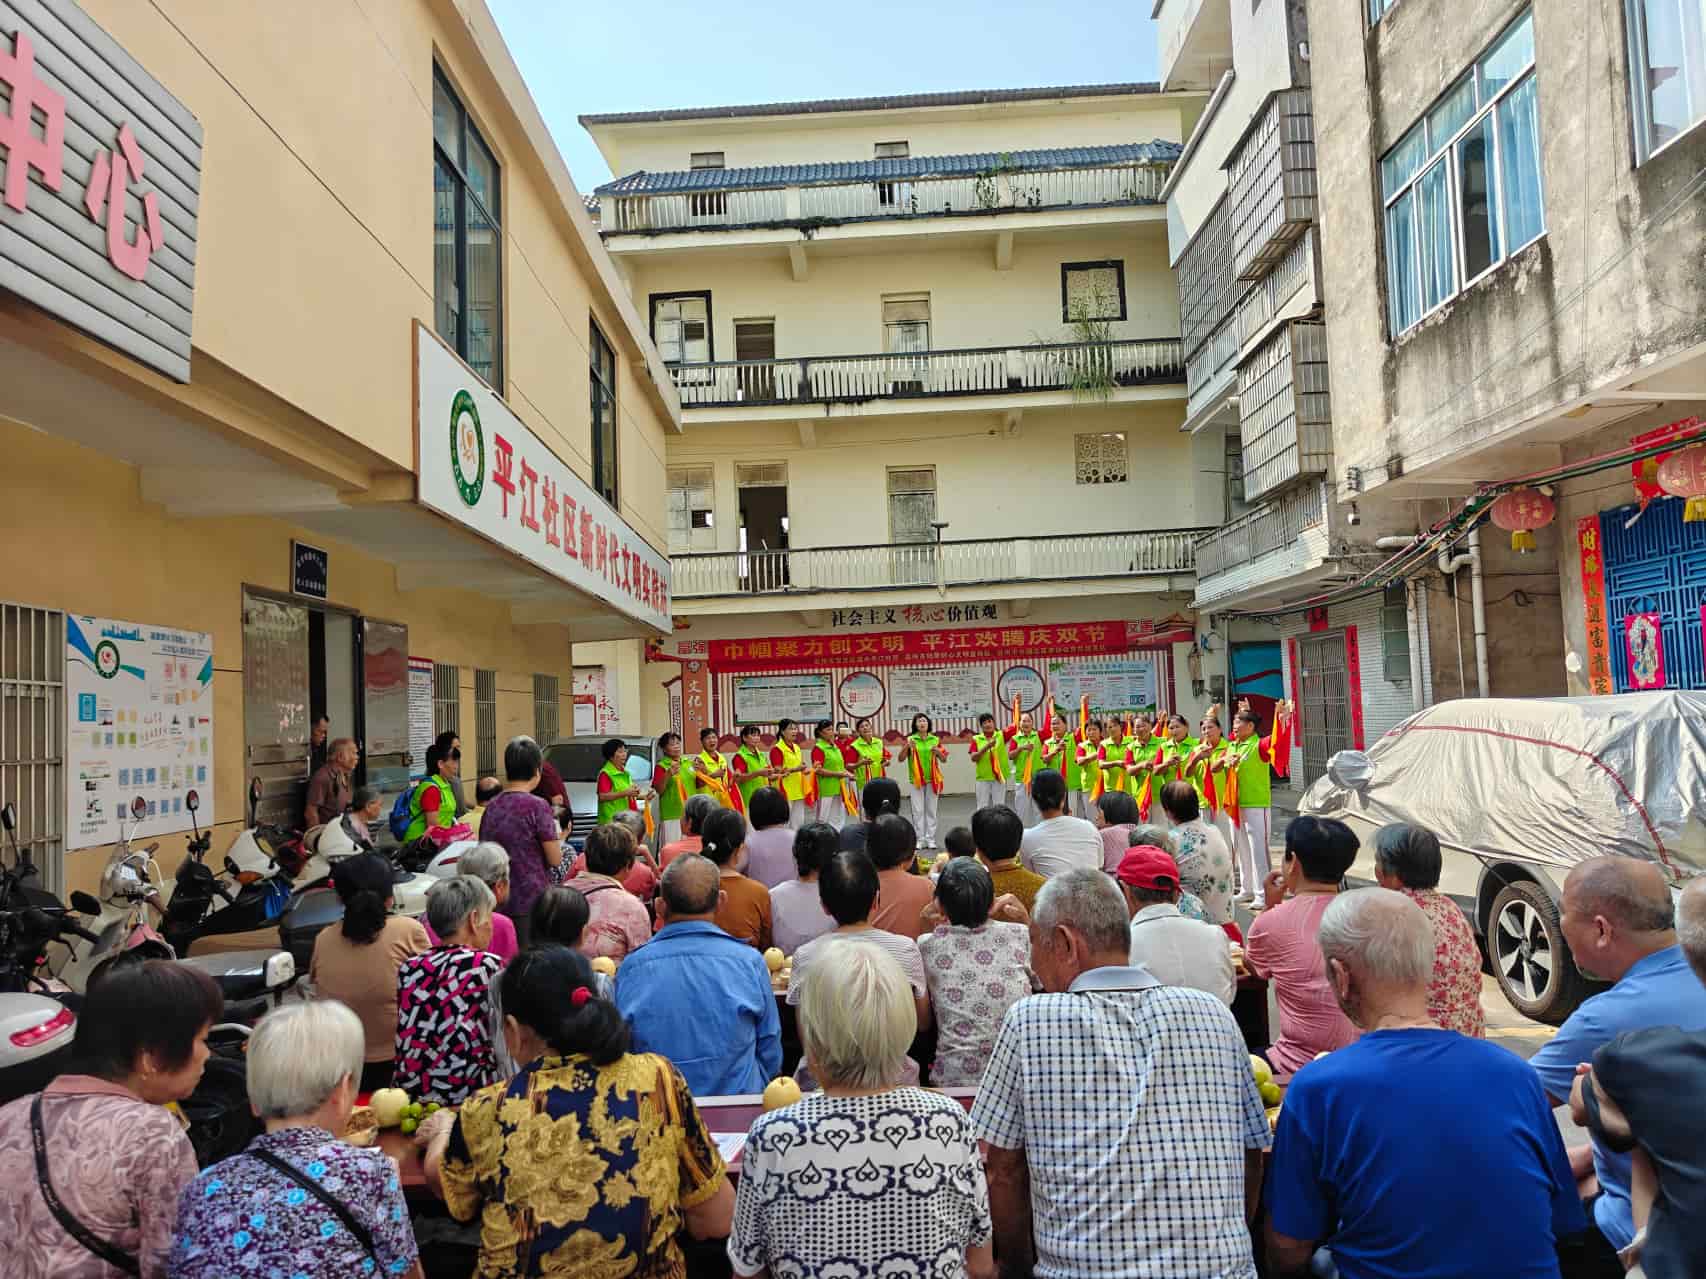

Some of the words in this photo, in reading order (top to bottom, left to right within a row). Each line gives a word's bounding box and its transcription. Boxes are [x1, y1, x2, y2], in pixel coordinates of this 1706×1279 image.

[0, 30, 163, 281] 中心
[724, 635, 904, 661] 巾帼聚力创文明
[920, 625, 1106, 651] 平江欢腾庆双节
